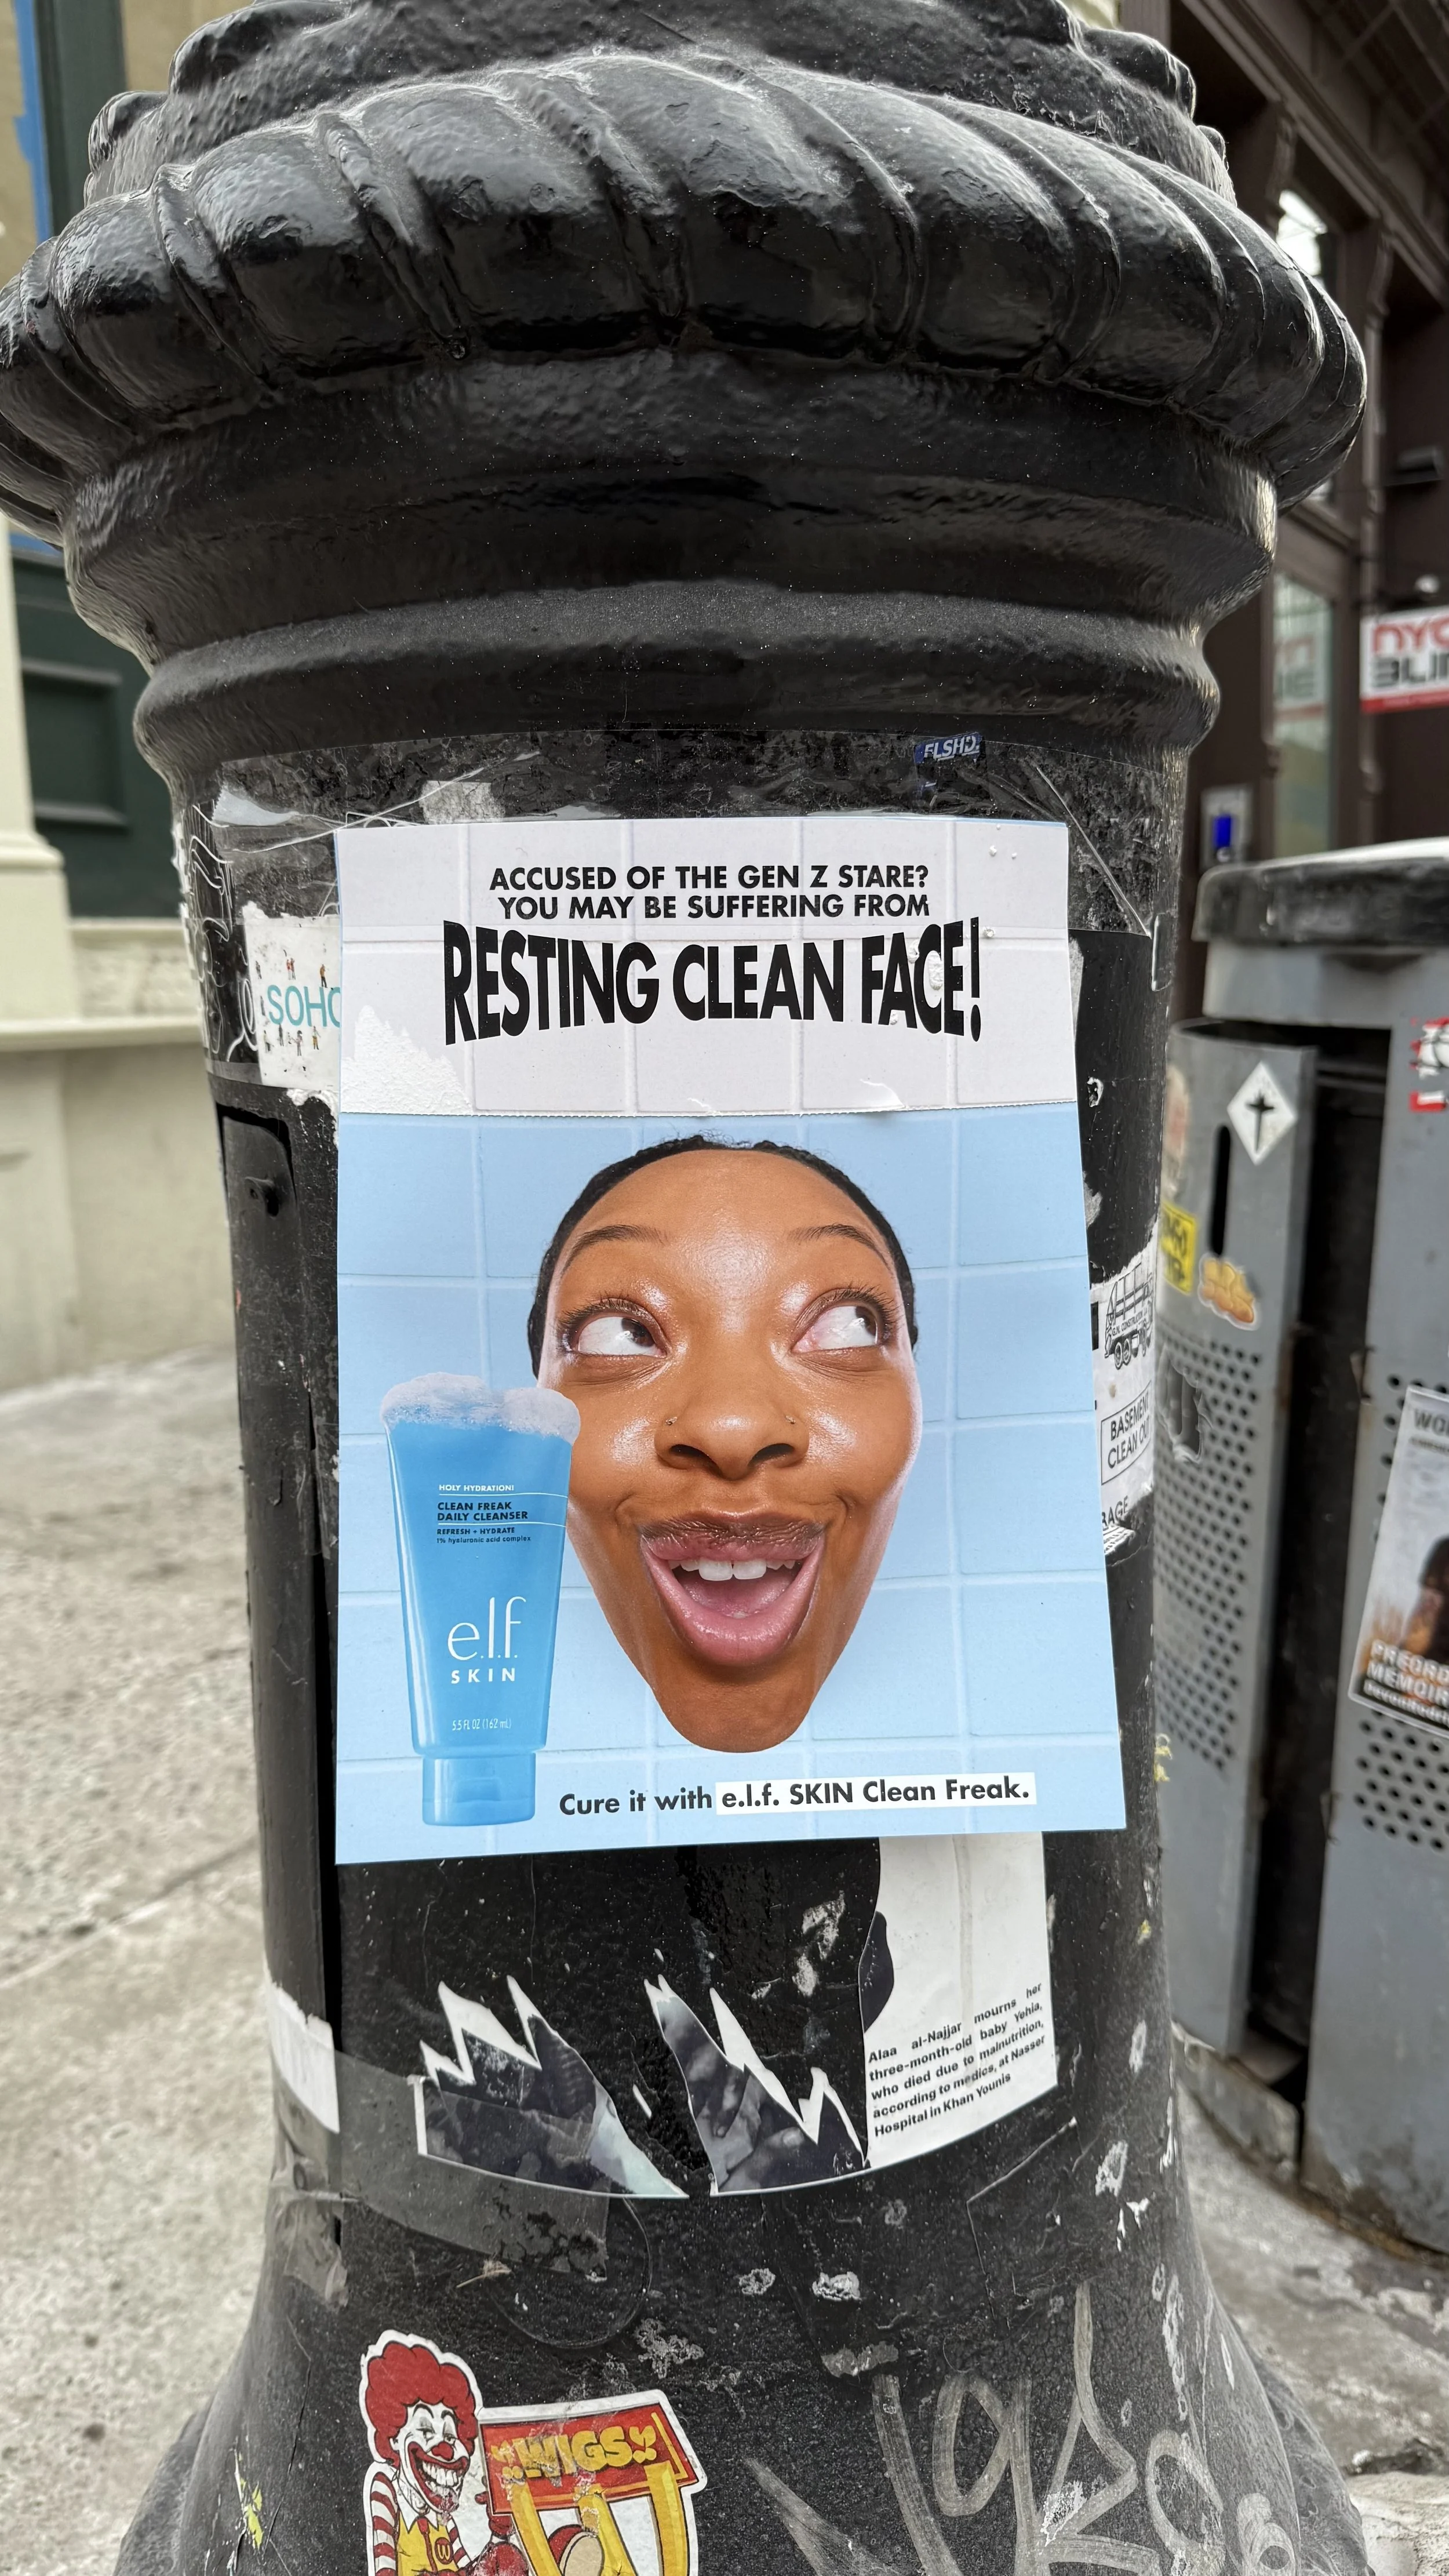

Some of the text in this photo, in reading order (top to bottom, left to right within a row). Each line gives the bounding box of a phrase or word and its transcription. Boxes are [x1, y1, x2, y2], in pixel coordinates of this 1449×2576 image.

[489, 864, 929, 890] ACCUSED OF THE GEN Z STARE?
[498, 893, 930, 920] YOU MAY BE SUFFERING FROM
[443, 916, 981, 1046] RESTING CLEAN FACE!
[1108, 1414, 1150, 1469] CLEAN OUT
[1111, 1391, 1149, 1441] BASEMENT
[438, 1501, 512, 1511] CLEAN FREAK
[438, 1511, 528, 1521] DAILY CLEANSER
[447, 1596, 526, 1661] e.l.f.
[451, 1668, 515, 1684] SKIN
[482, 1717, 498, 1730] (162
[559, 1775, 1029, 1815] Cure it with e.l.f. SKIN Clean Freak.
[869, 1982, 1042, 2063] Alaa al-Najjar mourns her
[869, 2001, 1042, 2081] three-month-old baby Yehia,
[871, 2020, 1044, 2100] who died due to malnutrition,
[873, 2035, 1046, 2118] according to medics, at Nasser
[875, 2072, 1011, 2137] Hospital in Khan Younis
